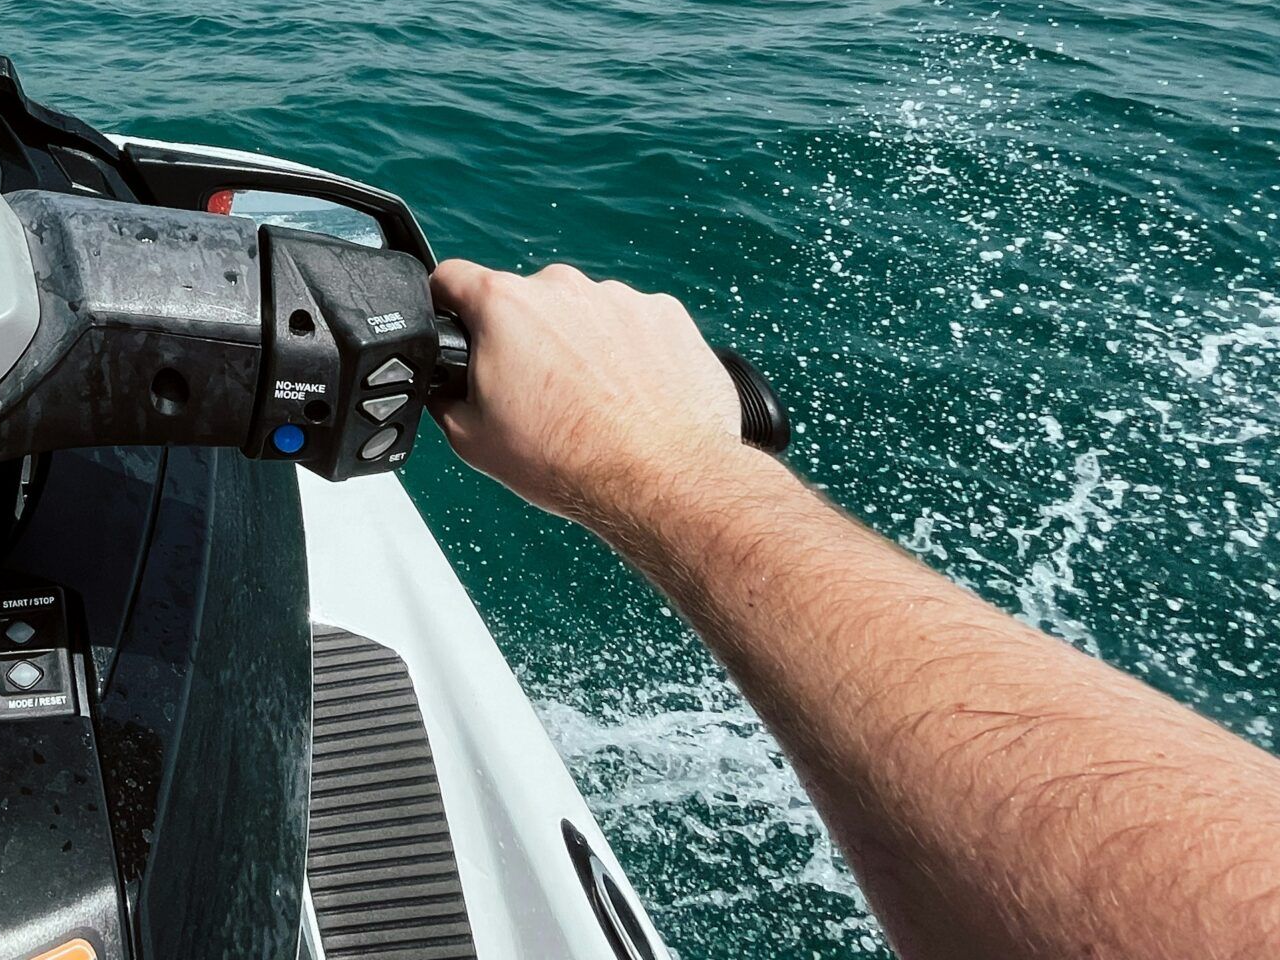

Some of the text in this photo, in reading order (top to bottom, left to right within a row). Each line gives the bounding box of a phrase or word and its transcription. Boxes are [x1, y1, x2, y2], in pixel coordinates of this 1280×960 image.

[367, 311, 404, 326] CRUISE
[374, 319, 408, 334] ASSIST
[275, 380, 326, 394] NO-WAKE
[274, 389, 306, 401] MODE
[388, 451, 407, 462] SET
